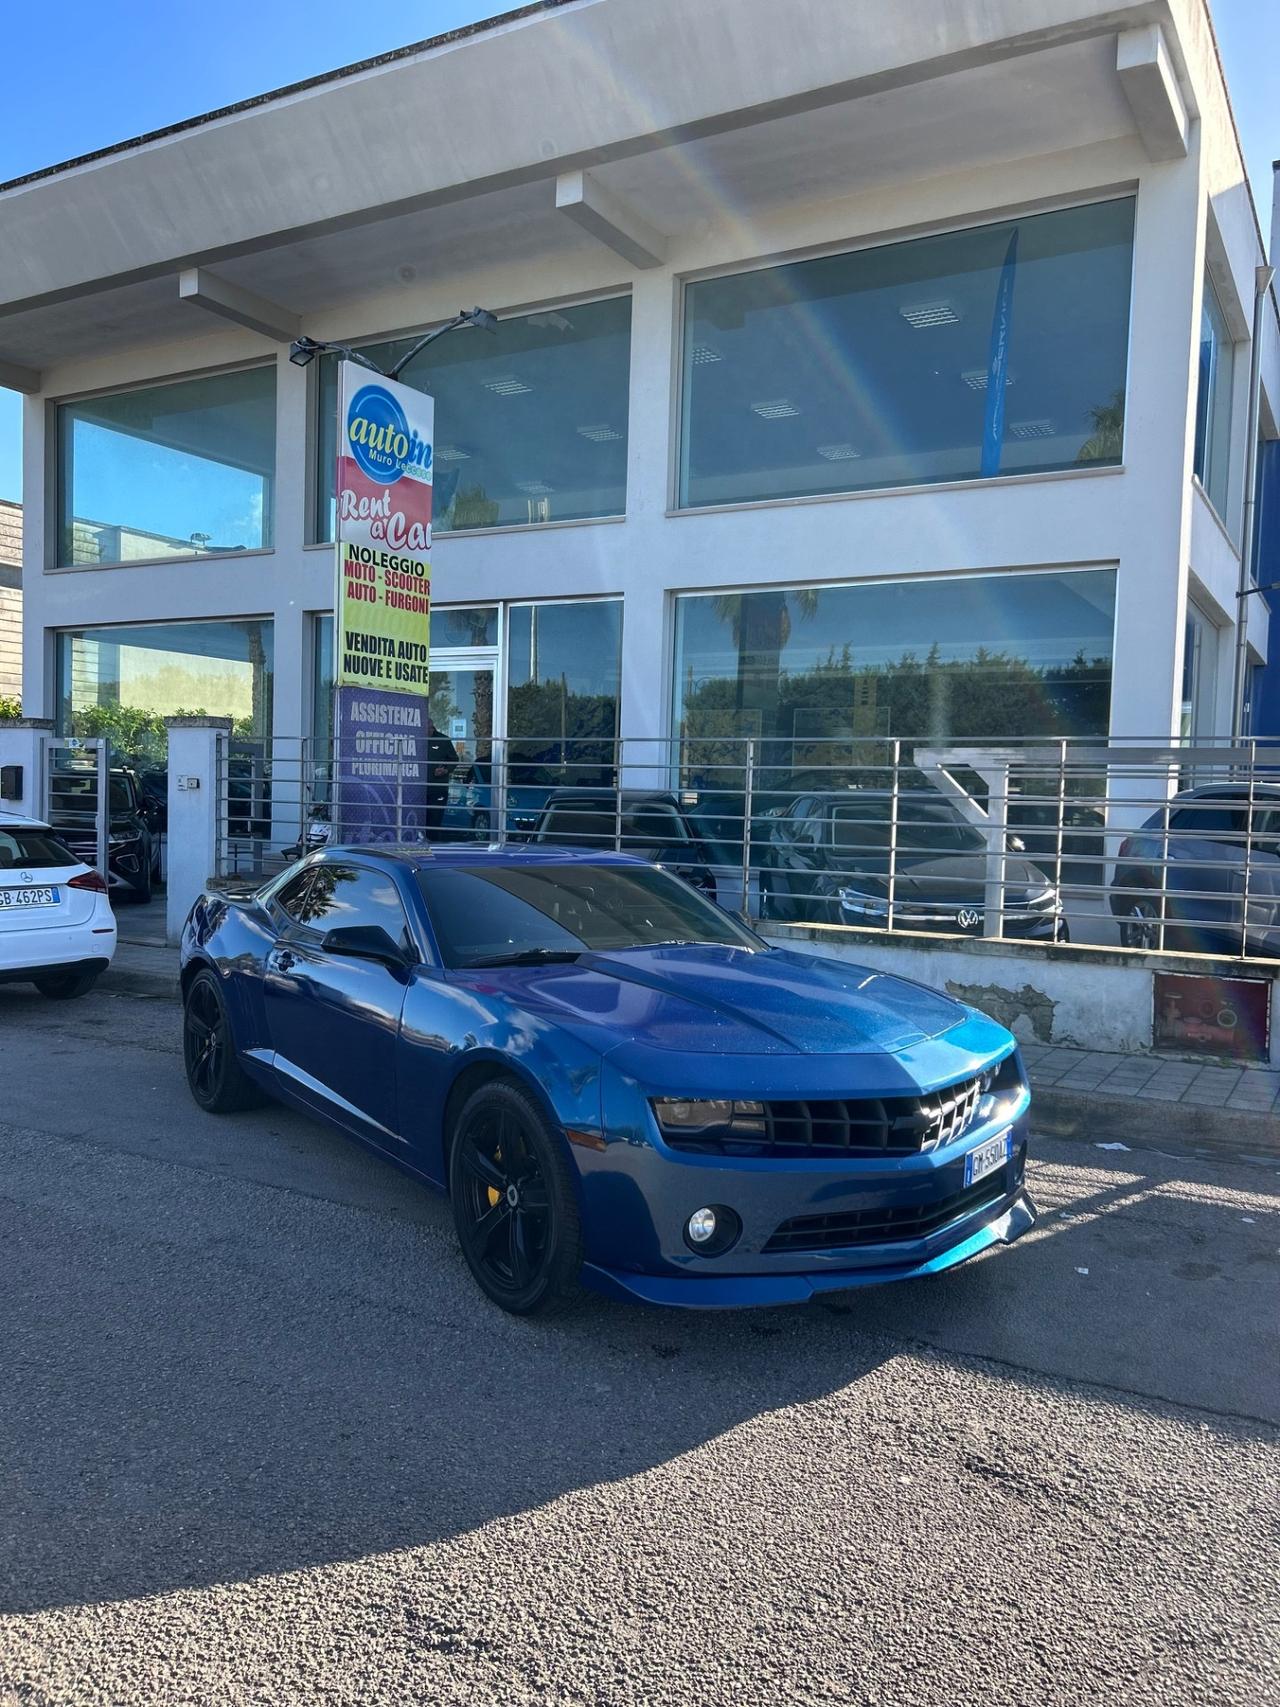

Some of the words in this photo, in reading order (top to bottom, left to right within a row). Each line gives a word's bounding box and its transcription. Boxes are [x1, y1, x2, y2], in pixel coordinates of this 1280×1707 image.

[368, 449, 393, 466] Muro
[341, 488, 391, 519] Rent
[371, 520, 384, 538] a
[349, 544, 425, 578] NOLEGGIO
[344, 559, 376, 583] MOTO
[384, 569, 430, 596] SCOOTER
[347, 581, 376, 604] AUTO
[385, 590, 429, 615] FURGONI
[345, 631, 396, 658] VENDITA
[398, 641, 427, 663] AUTO
[344, 653, 384, 678] NUOVE
[385, 660, 393, 680] E
[395, 662, 429, 684] USATE
[350, 701, 422, 728] ASSISTENZA
[355, 730, 417, 757] OFFICINA
[16, 890, 52, 904] 462PS
